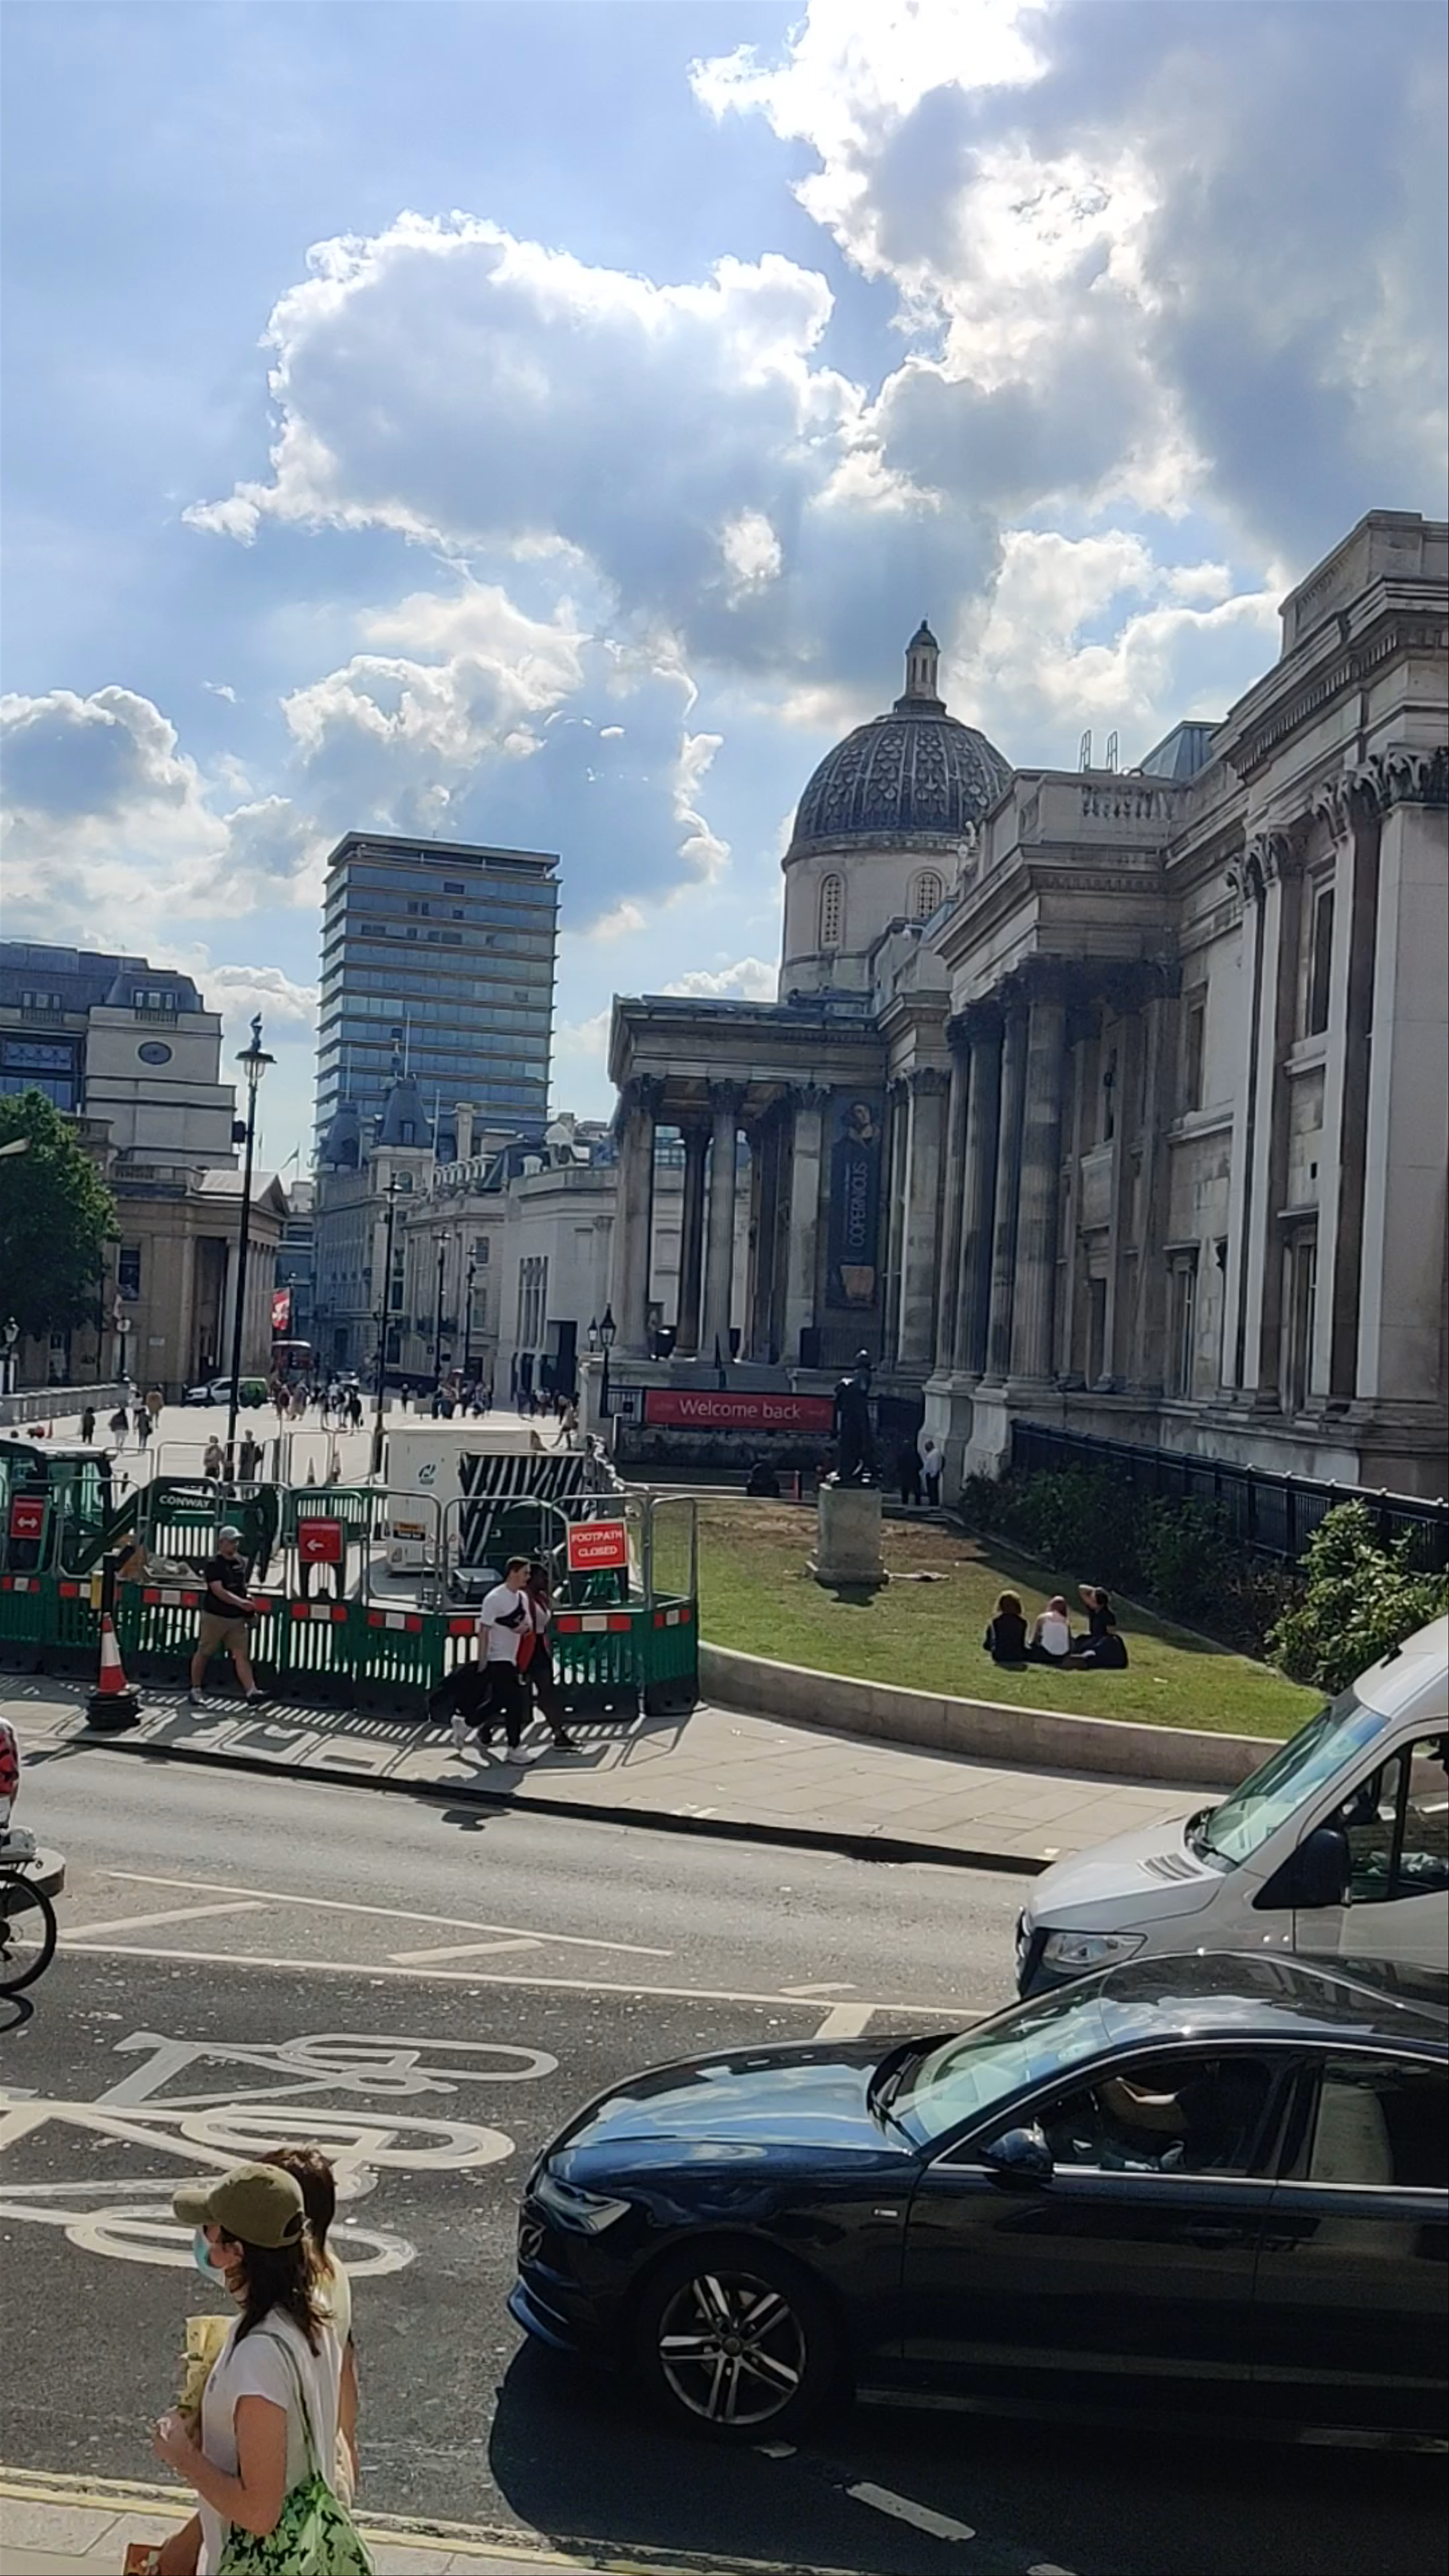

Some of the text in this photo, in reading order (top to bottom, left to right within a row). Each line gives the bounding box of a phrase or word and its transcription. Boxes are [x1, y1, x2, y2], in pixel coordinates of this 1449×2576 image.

[679, 1399, 757, 1418] Welcome
[762, 1403, 800, 1419] back
[159, 1495, 211, 1508] CONWAY
[571, 1530, 623, 1543] FOOTPATH
[578, 1545, 617, 1557] CLOSED
